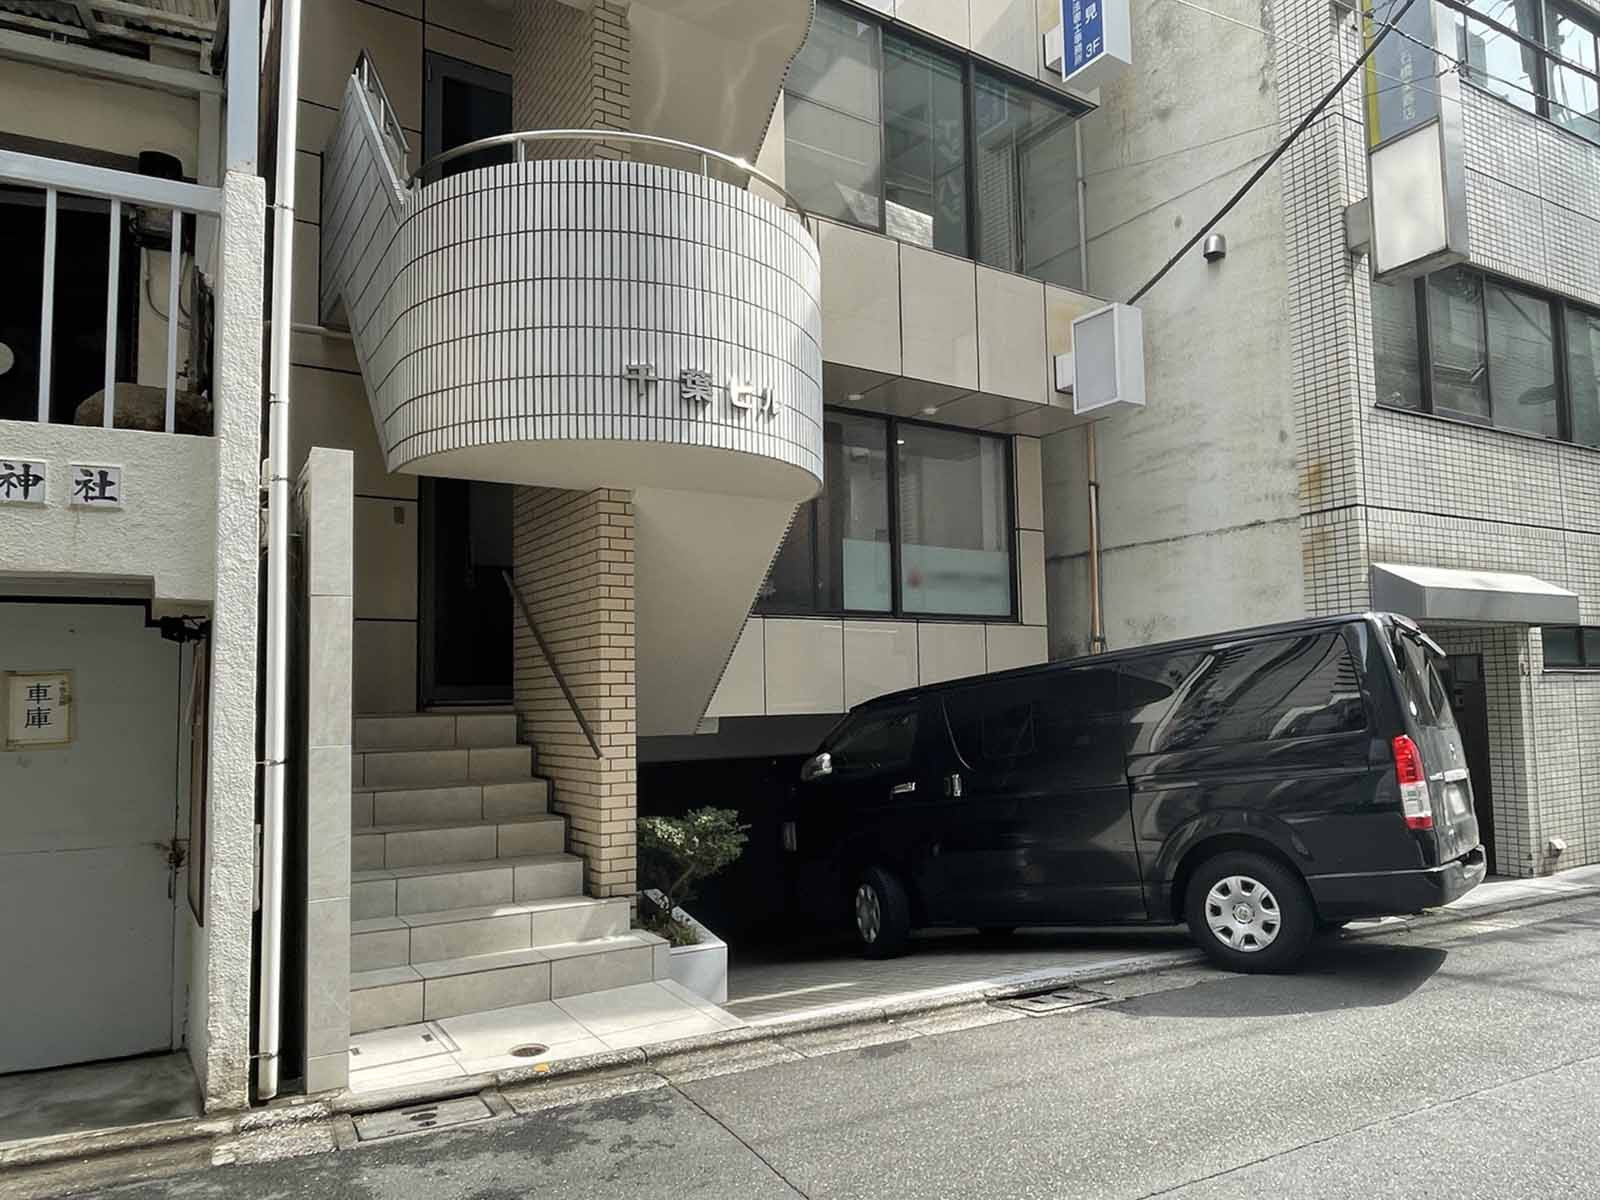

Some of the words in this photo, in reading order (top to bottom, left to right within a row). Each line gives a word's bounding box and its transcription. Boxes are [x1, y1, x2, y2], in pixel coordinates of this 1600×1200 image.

[1085, 36, 1101, 58] 3F
[623, 362, 782, 418] 千葉ビル
[24, 682, 54, 729] 車庫
